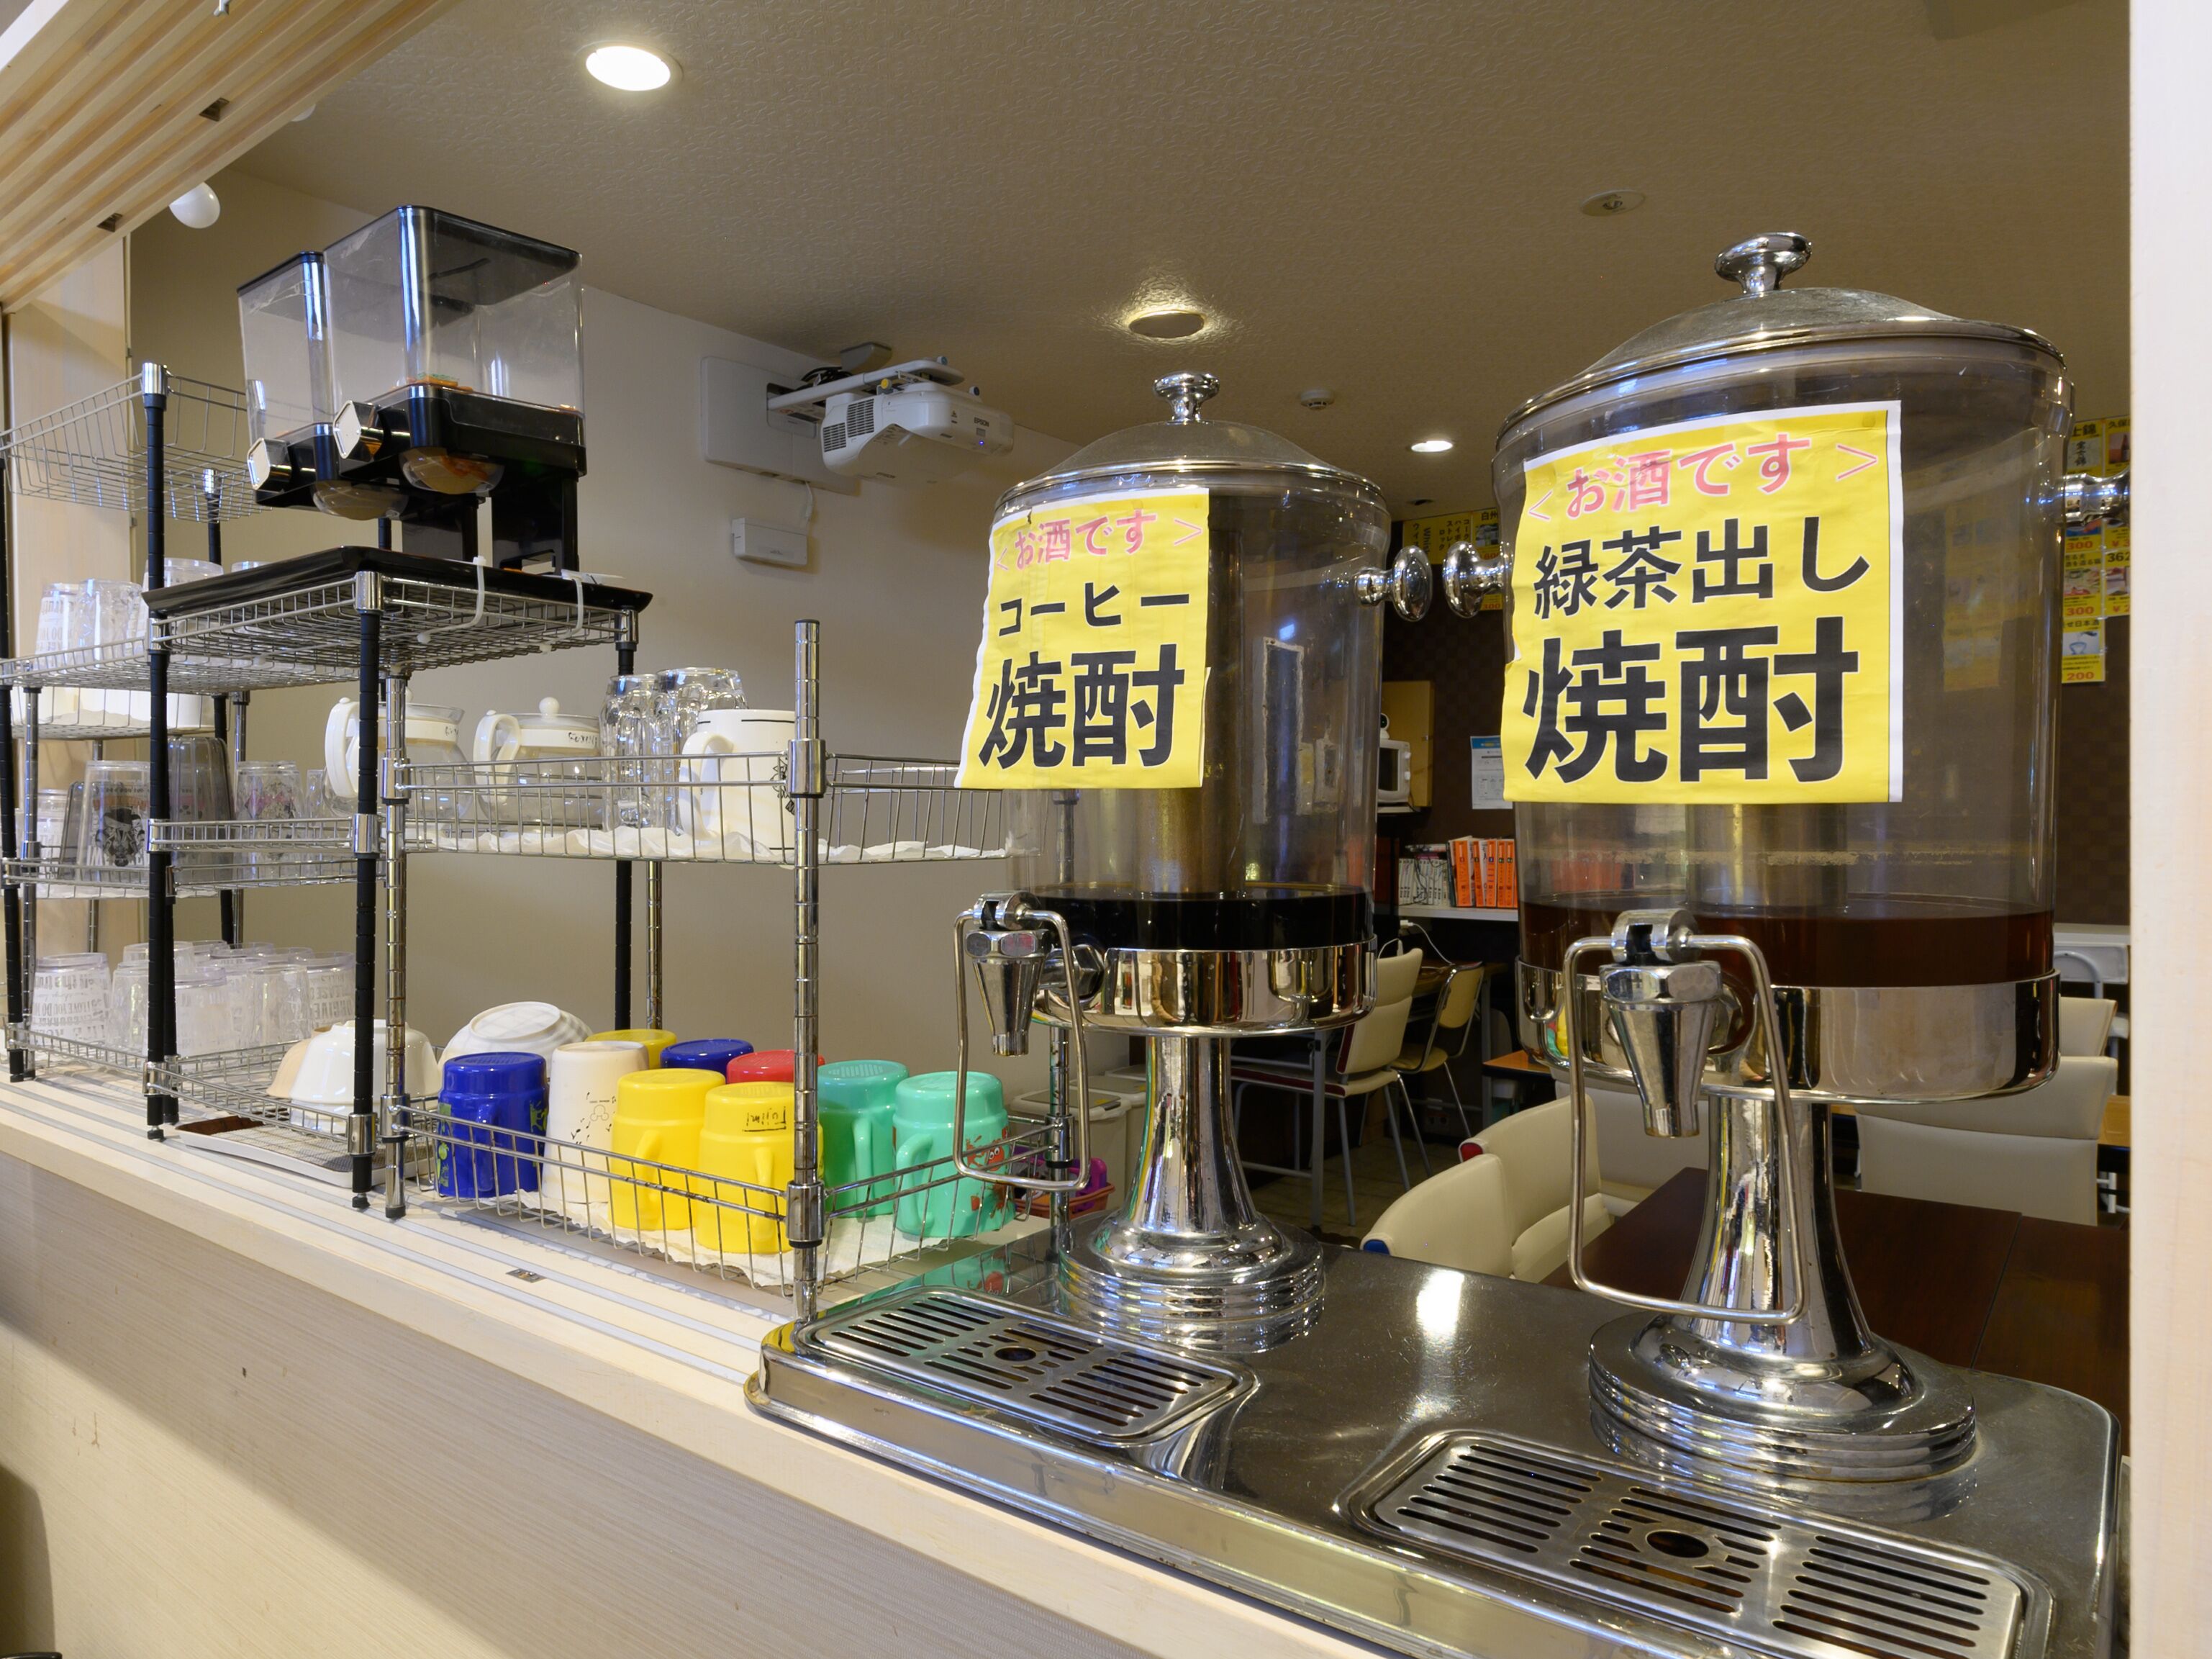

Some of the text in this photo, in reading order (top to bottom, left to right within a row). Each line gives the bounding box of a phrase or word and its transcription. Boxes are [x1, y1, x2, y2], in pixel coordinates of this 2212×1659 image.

[1533, 516, 1870, 620] 緑茶出し
[999, 582, 1189, 637] コーヒー
[2067, 607, 2094, 616] 300
[979, 643, 1185, 769] 焼酎
[1522, 616, 1859, 783] 焼酎
[2067, 672, 2095, 681] 200
